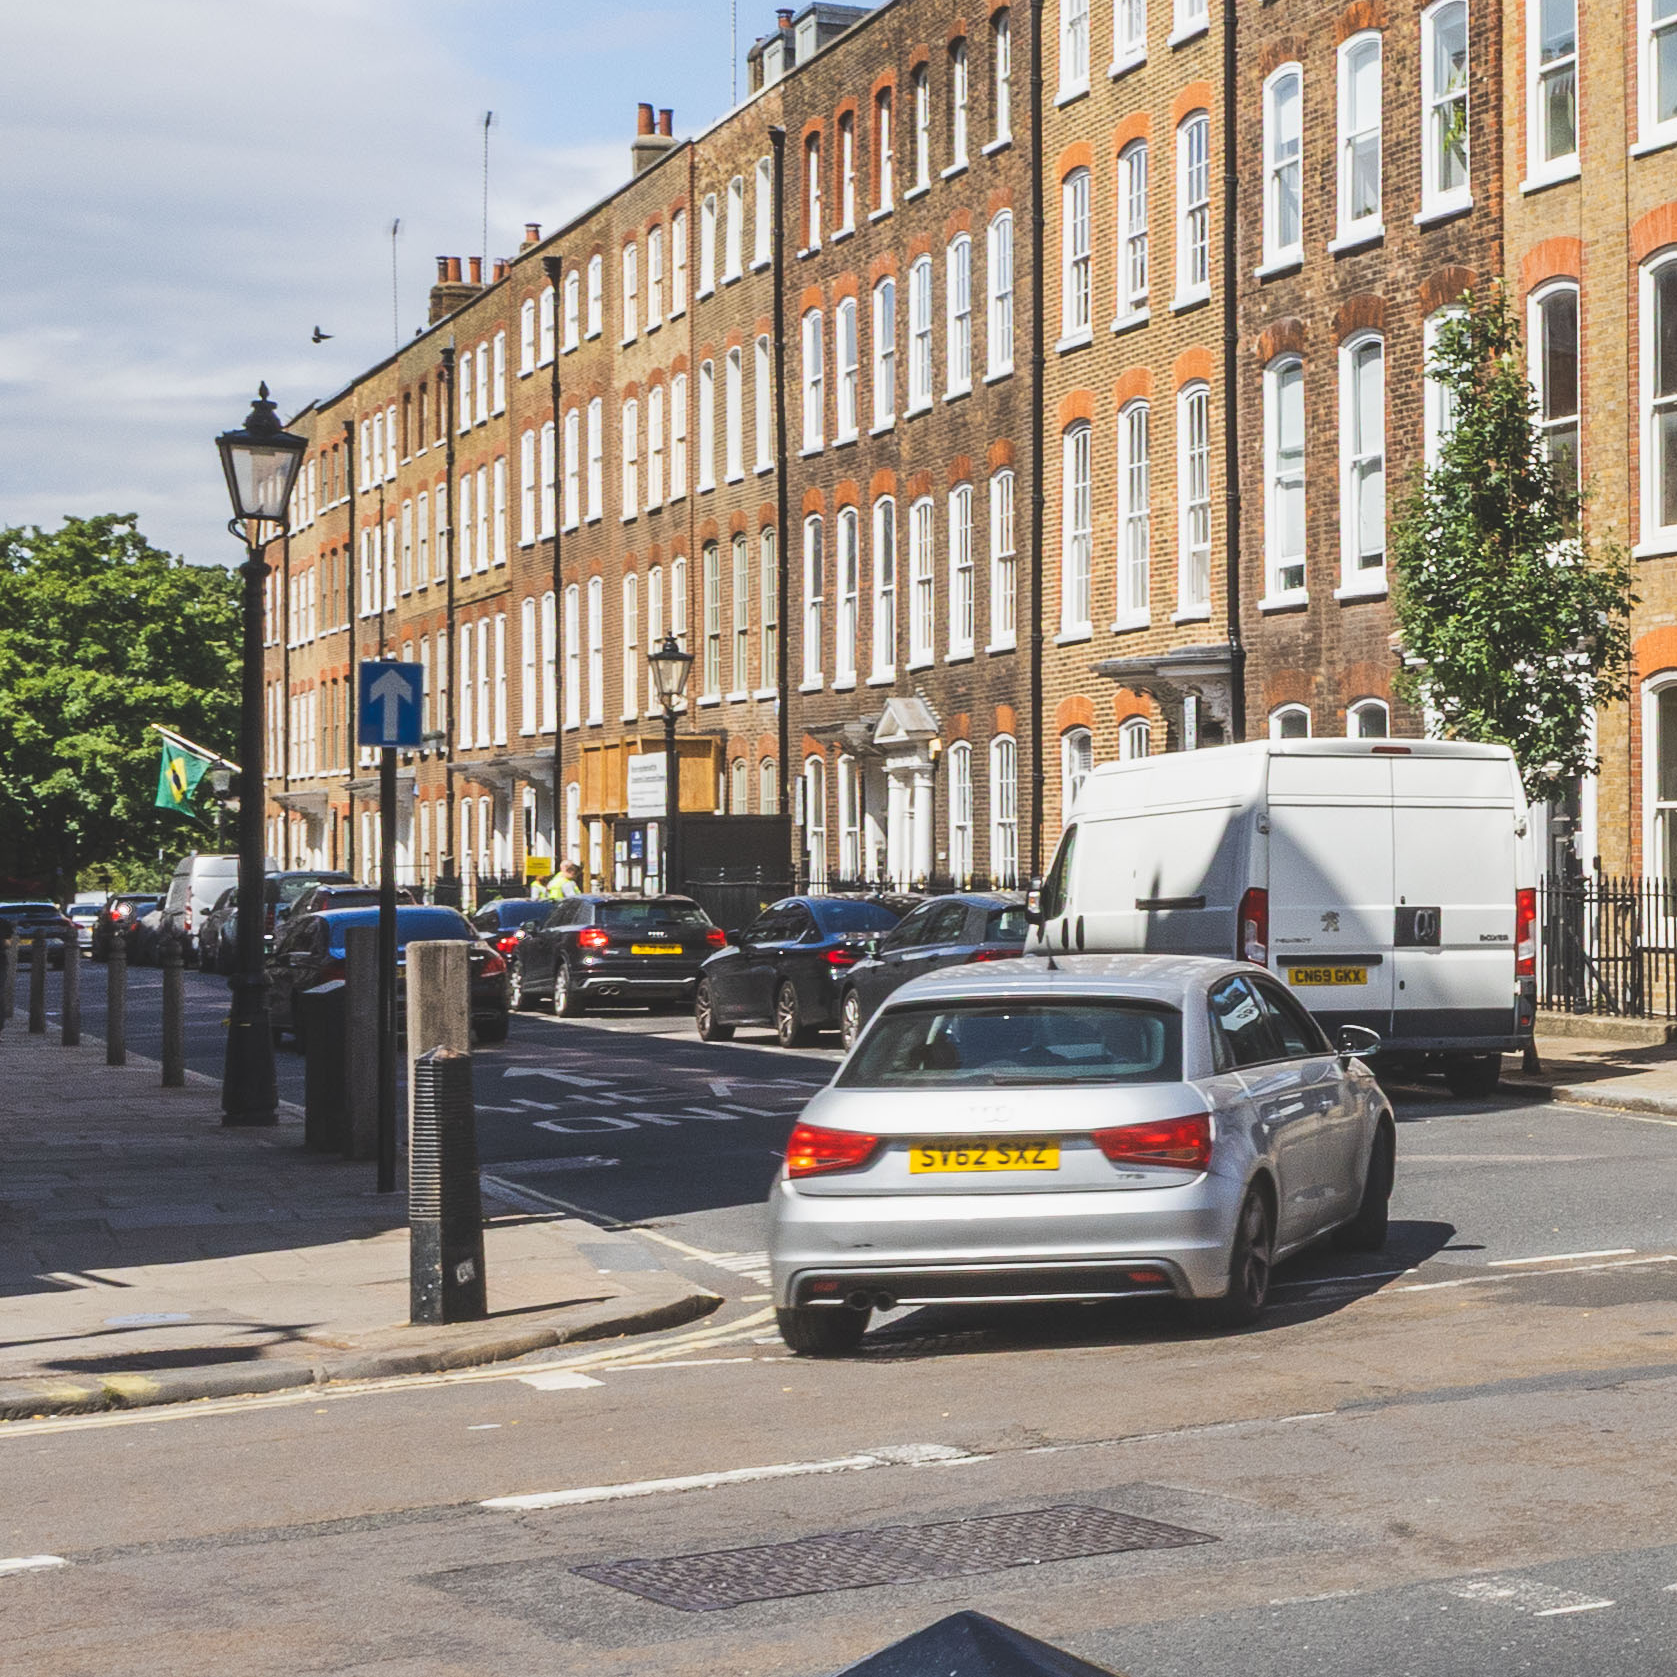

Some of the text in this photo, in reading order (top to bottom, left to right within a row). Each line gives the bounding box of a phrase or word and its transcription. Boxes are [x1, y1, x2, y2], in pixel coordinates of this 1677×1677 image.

[1295, 968, 1362, 983] CN69 GKX
[921, 1142, 1047, 1167] SV62 SXZ
